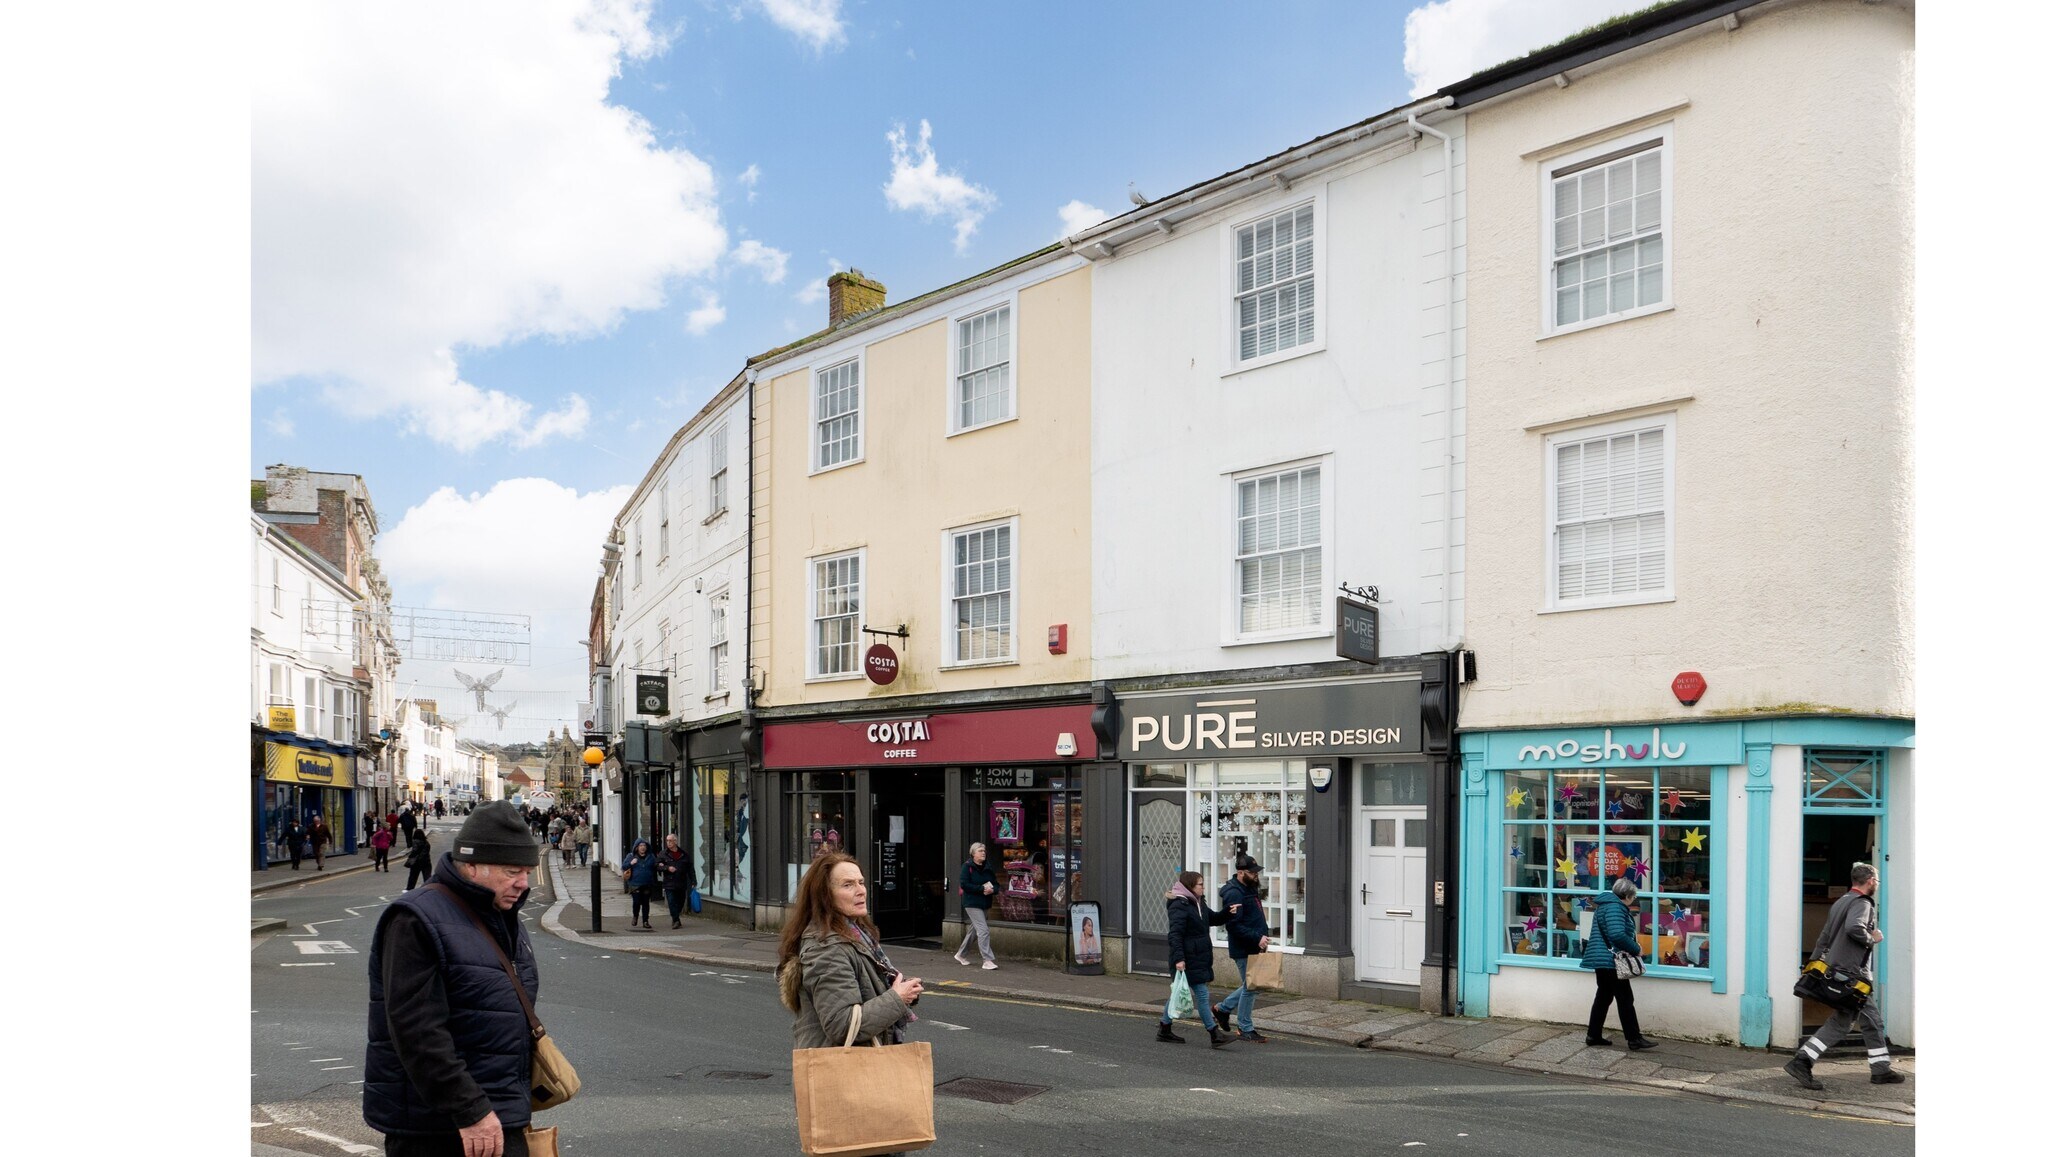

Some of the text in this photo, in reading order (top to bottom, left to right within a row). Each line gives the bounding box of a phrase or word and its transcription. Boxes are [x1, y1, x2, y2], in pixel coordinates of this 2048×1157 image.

[1344, 617, 1374, 639] PURE
[869, 656, 896, 668] COSTA
[640, 680, 666, 689] FATFACE
[867, 721, 930, 745] COSTA
[1132, 709, 1401, 752] PURE SILVER DESIGN
[884, 748, 918, 758] COFFEE
[1518, 727, 1687, 763] moshulu
